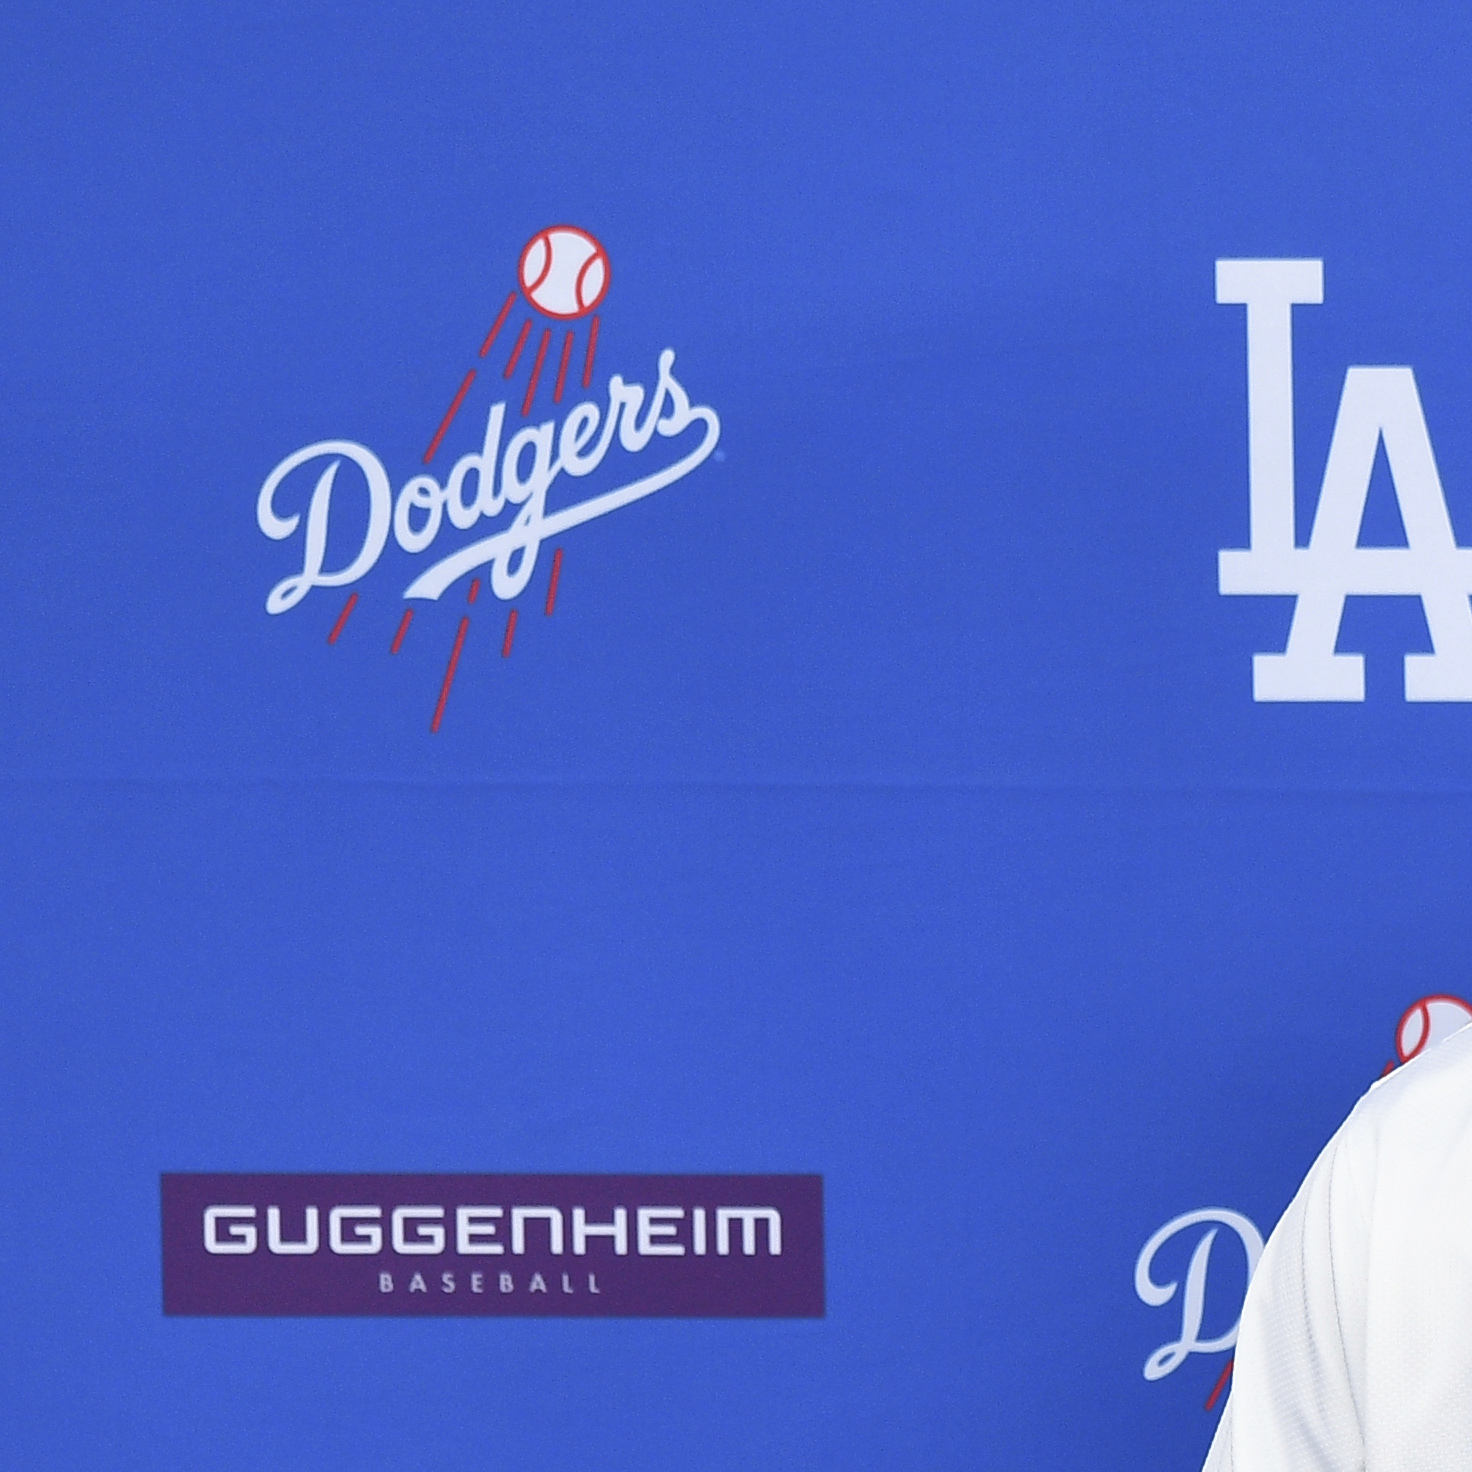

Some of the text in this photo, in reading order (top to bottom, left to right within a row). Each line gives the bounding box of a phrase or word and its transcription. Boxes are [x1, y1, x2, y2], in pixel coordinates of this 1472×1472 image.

[257, 348, 720, 616] Dodgers
[203, 1204, 783, 1257] GUGGENHEIM
[378, 1272, 601, 1294] BASEBALL
